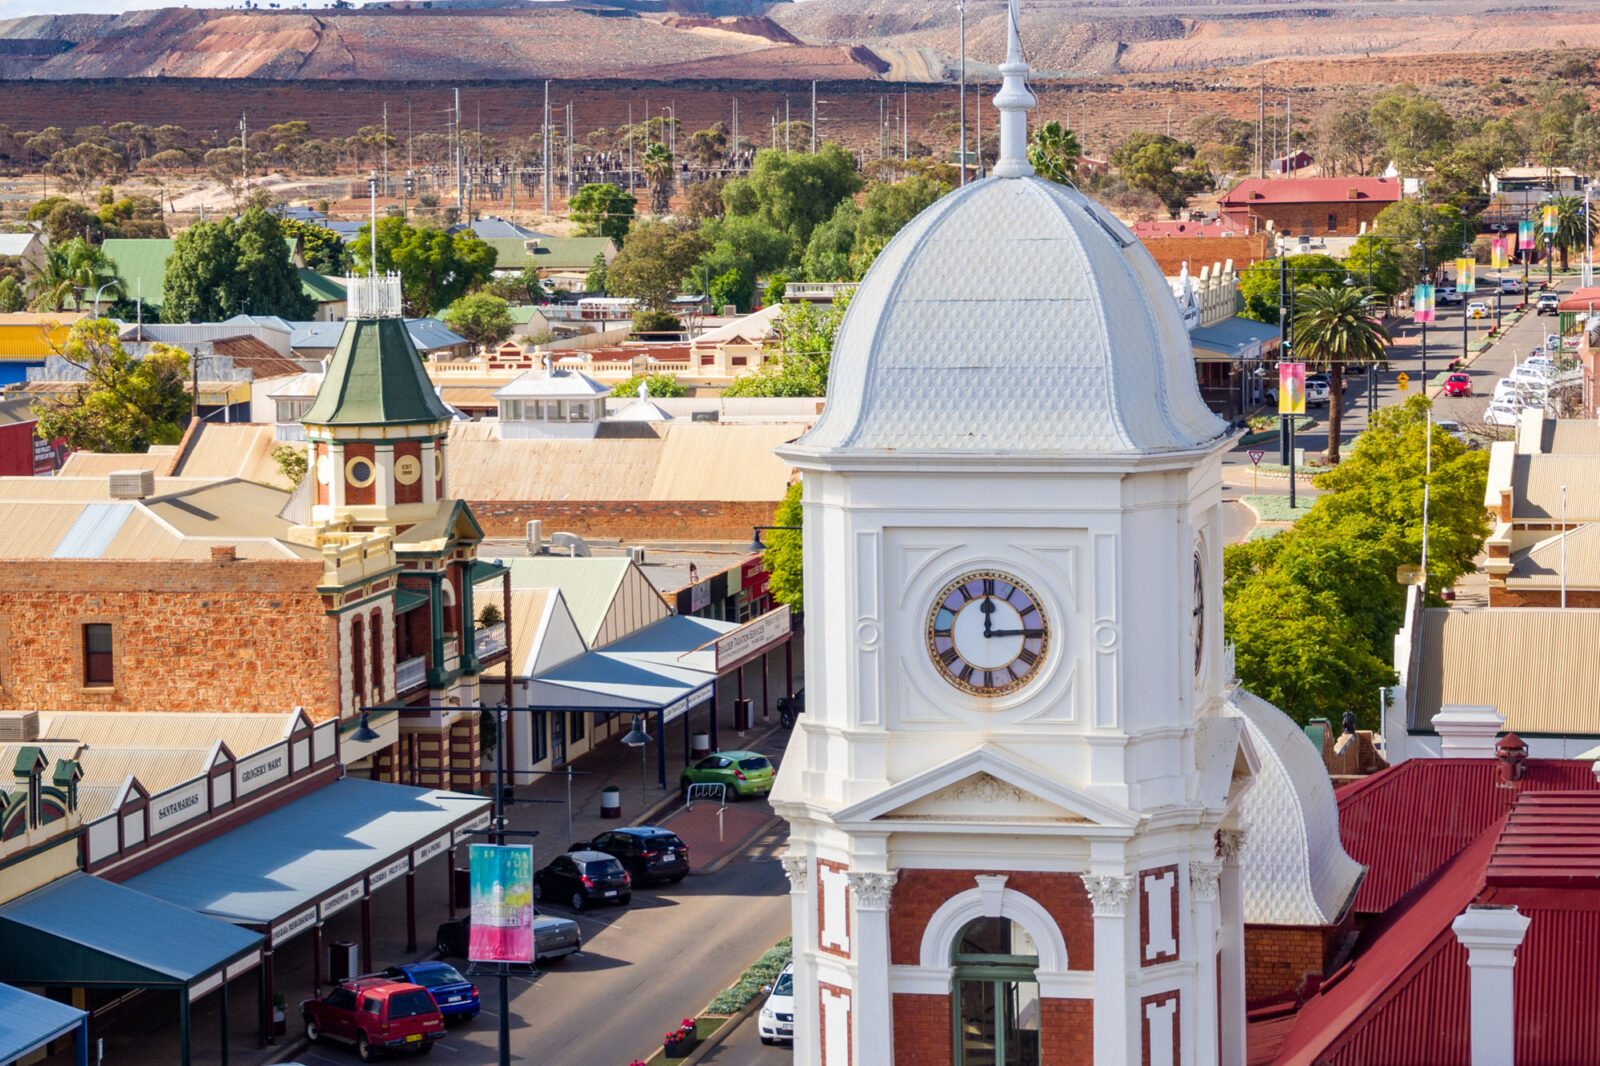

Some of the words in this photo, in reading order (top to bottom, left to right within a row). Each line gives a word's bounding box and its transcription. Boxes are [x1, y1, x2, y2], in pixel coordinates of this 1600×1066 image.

[242, 764, 267, 783] GROCERY
[268, 757, 282, 772] MART
[159, 793, 199, 819] SANTAMARIAS
[288, 910, 316, 930] MERCHANDISE
